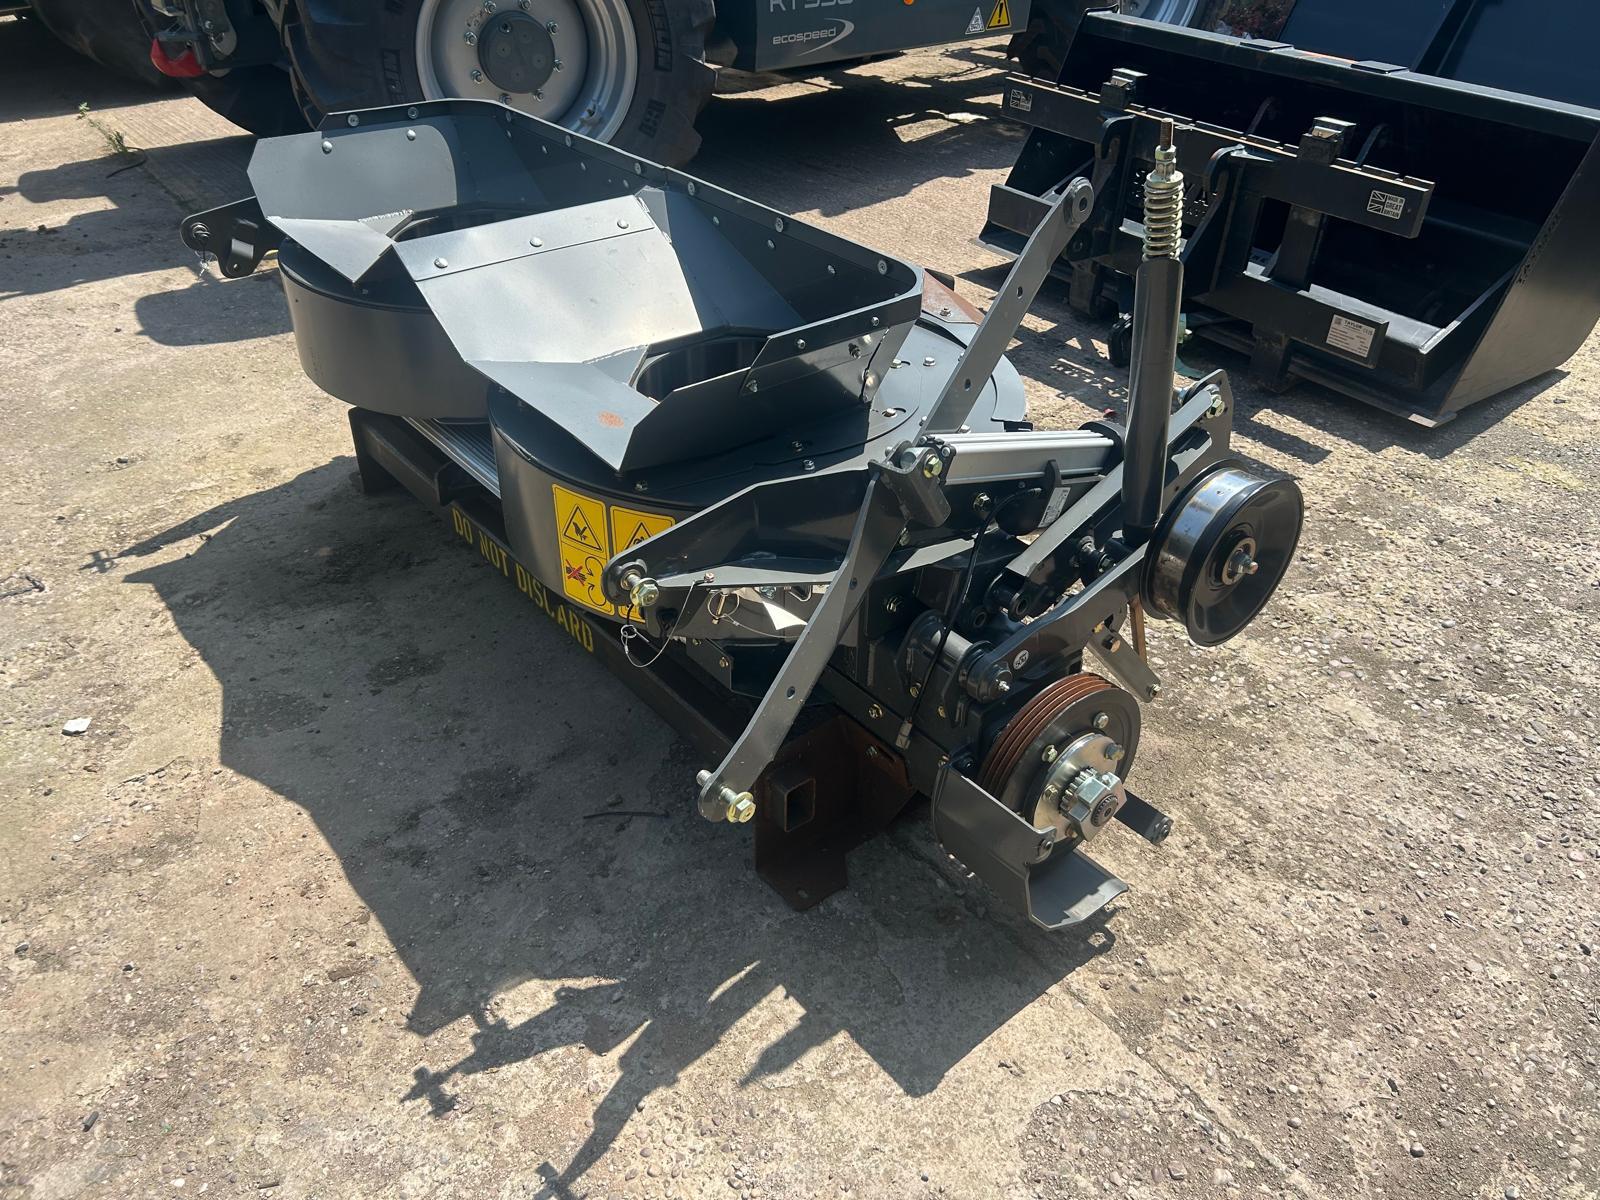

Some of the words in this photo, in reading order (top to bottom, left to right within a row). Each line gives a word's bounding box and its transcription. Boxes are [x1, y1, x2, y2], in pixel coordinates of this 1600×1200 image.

[772, 27, 837, 45] ecospeed
[1386, 201, 1402, 211] GREAT
[452, 507, 473, 544] DO
[479, 530, 508, 577] NOT
